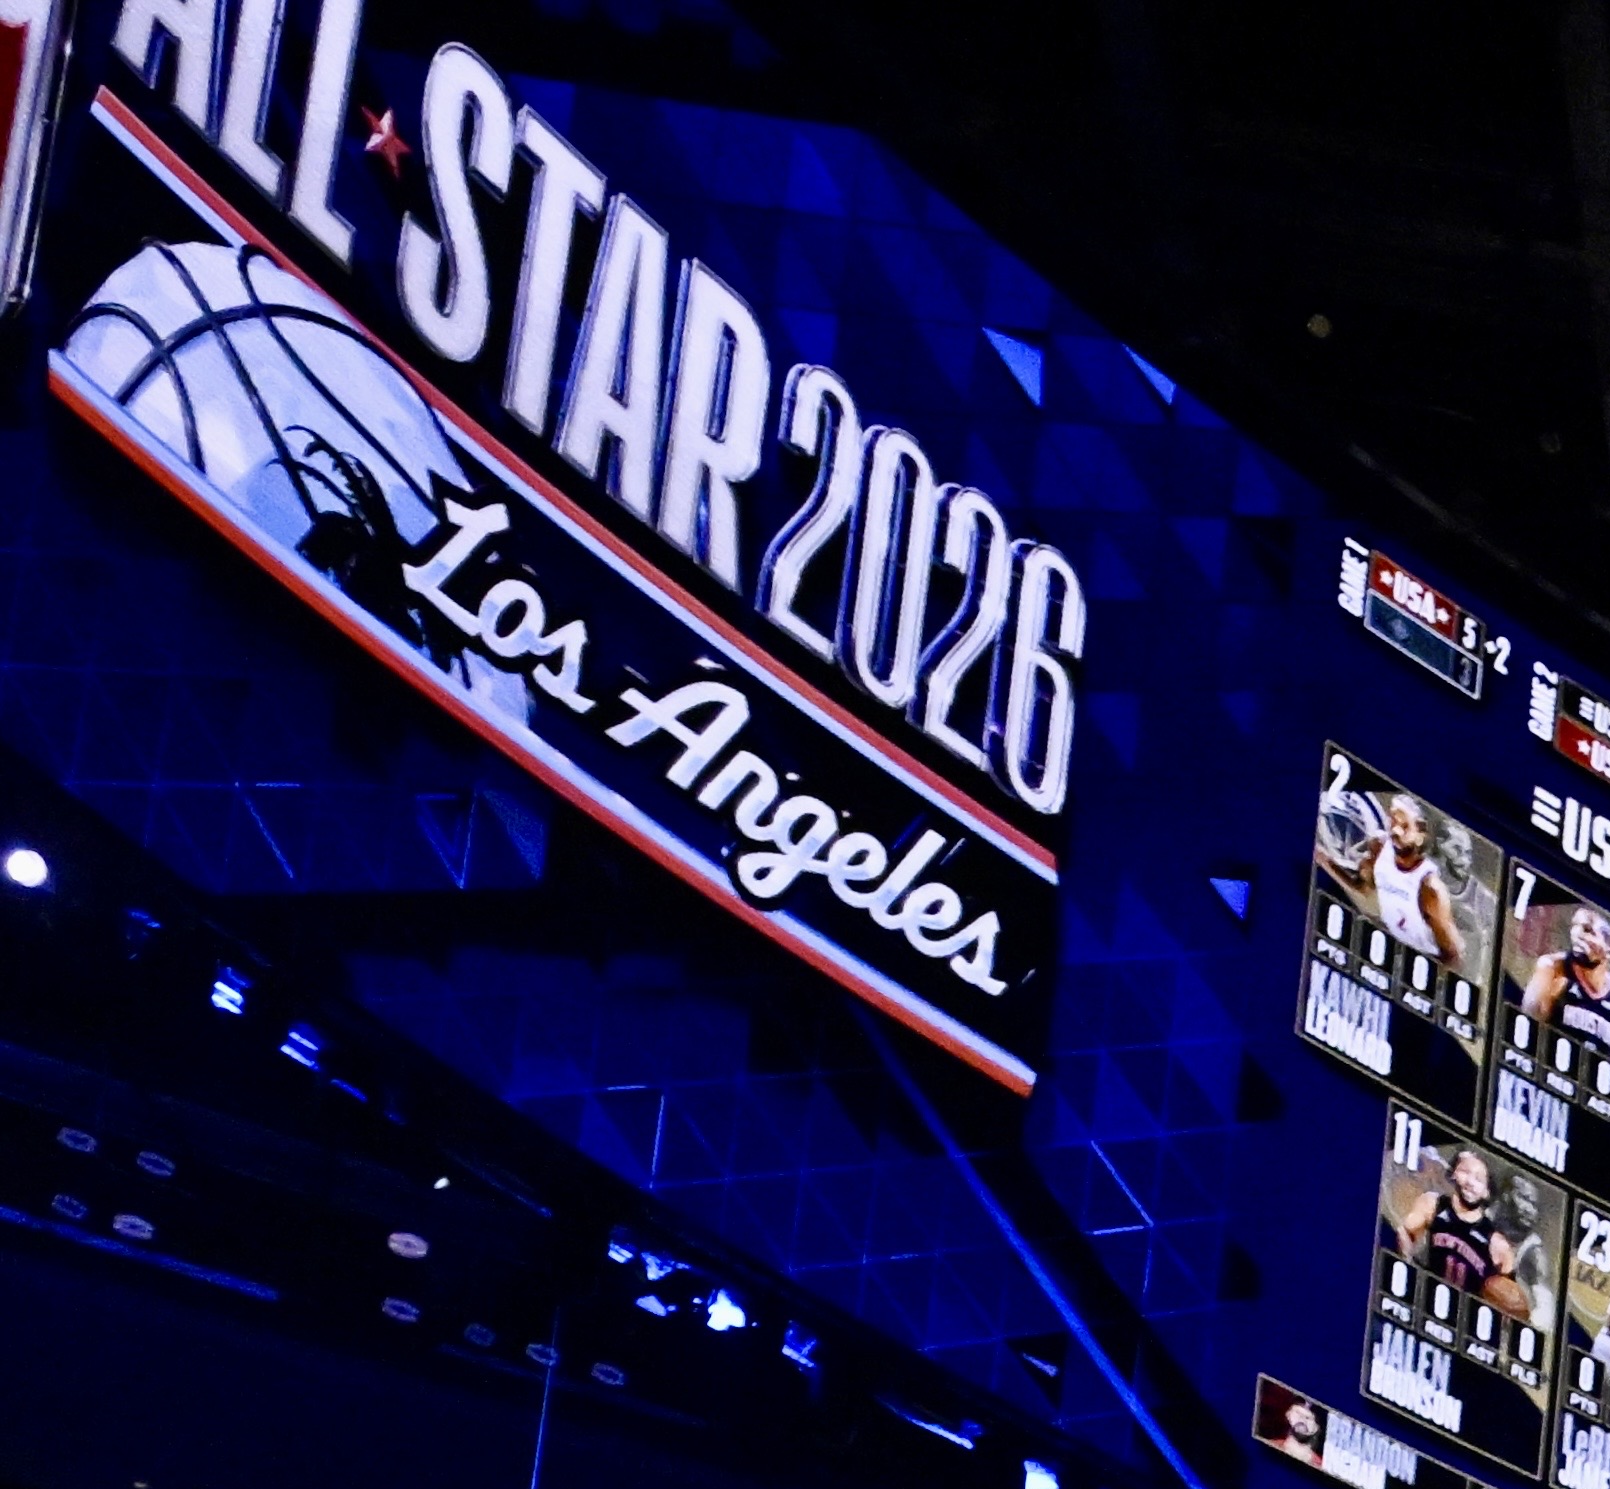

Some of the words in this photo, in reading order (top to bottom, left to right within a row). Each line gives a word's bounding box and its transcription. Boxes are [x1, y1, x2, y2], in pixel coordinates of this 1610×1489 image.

[398, 42, 772, 596] STAR
[754, 363, 1088, 814] 2026
[1392, 571, 1438, 624] USA
[1462, 618, 1477, 650] 5
[401, 494, 596, 715] Los
[604, 676, 1007, 997] Angeles
[1330, 755, 1350, 792] 2
[1514, 868, 1536, 919] 7
[1394, 1111, 1422, 1171] 11
